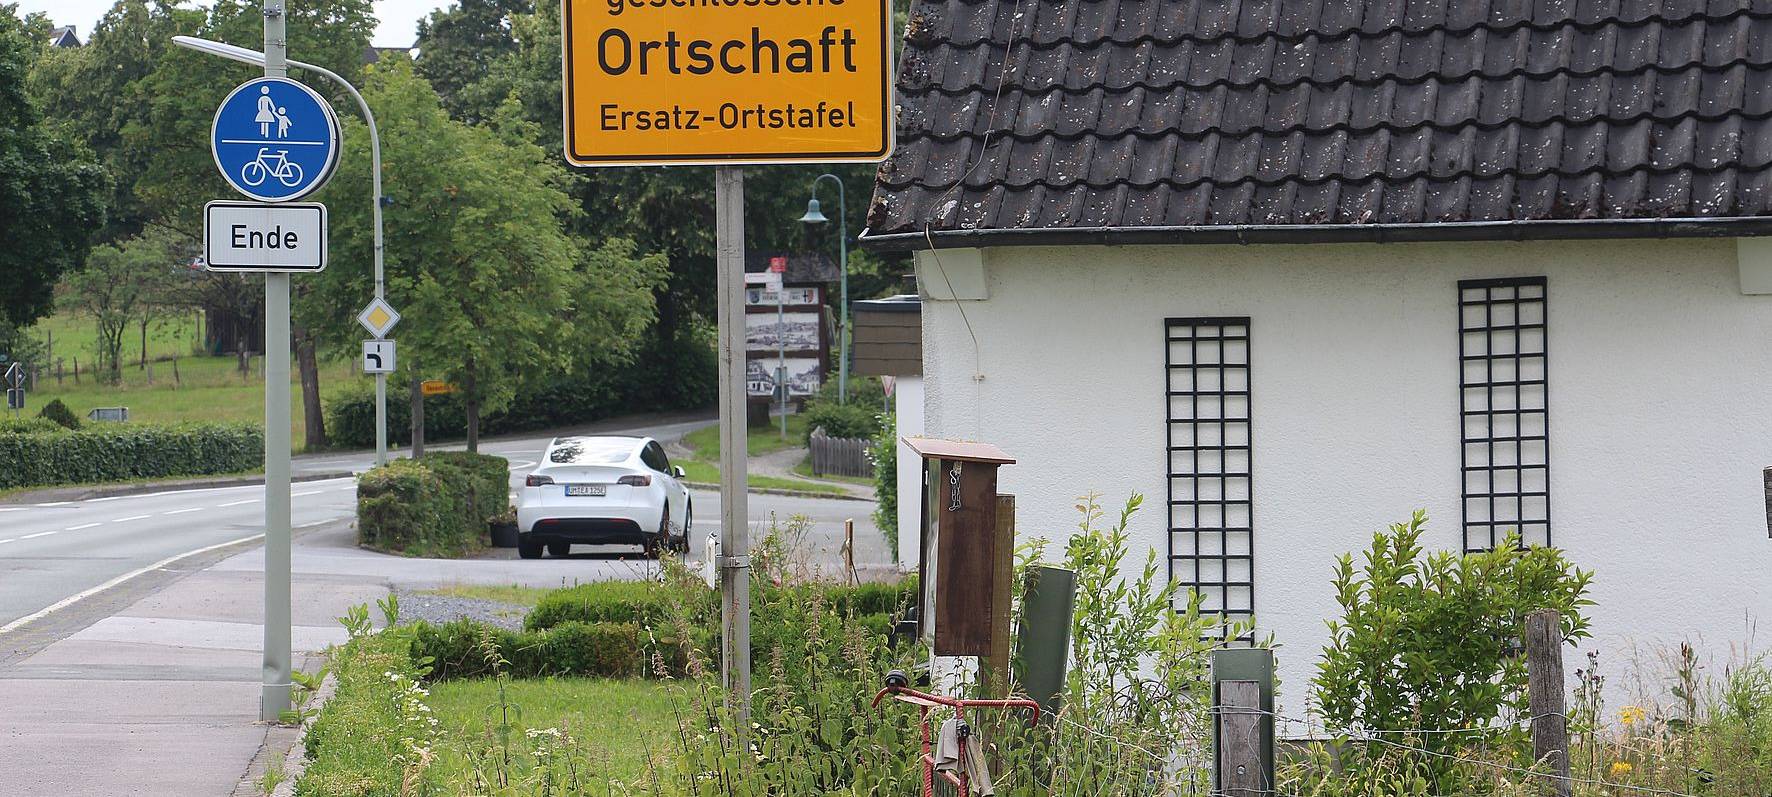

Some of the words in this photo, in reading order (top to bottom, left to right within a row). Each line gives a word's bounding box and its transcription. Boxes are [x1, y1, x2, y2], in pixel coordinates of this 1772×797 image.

[597, 25, 857, 76] Ortschaft
[600, 101, 856, 131] Ersatz-Ortstafel
[231, 224, 298, 249] Ende
